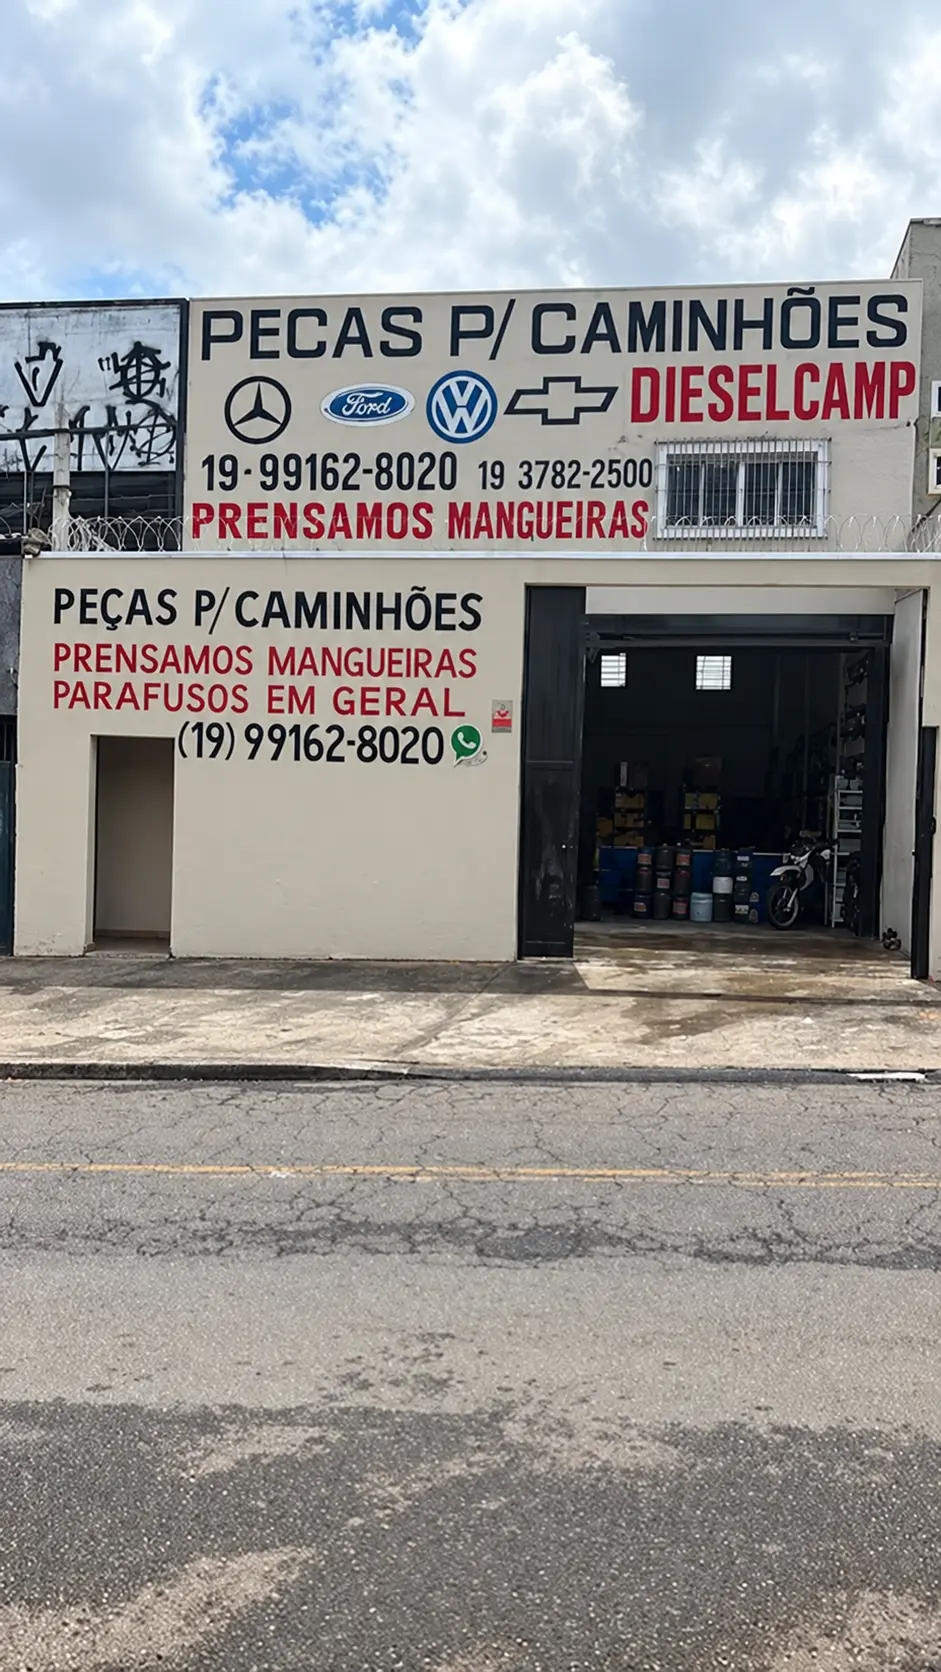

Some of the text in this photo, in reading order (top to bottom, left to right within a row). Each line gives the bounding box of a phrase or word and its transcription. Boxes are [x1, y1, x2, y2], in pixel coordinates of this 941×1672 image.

[202, 287, 908, 361] PECAS P/ CAMINHÕES
[342, 391, 391, 416] Ford
[631, 361, 916, 423] DIESELCAMP
[478, 458, 652, 490] 19 3782-2500
[192, 500, 648, 540] PRENSAMOS MANGUEIRAS
[53, 588, 178, 631] PEÇAS
[54, 643, 477, 679] PRENSAMOS MANGUEIRAS
[53, 680, 466, 717] PARAFUSOS EM GERAL
[178, 721, 445, 765] (19) 99162-8020
